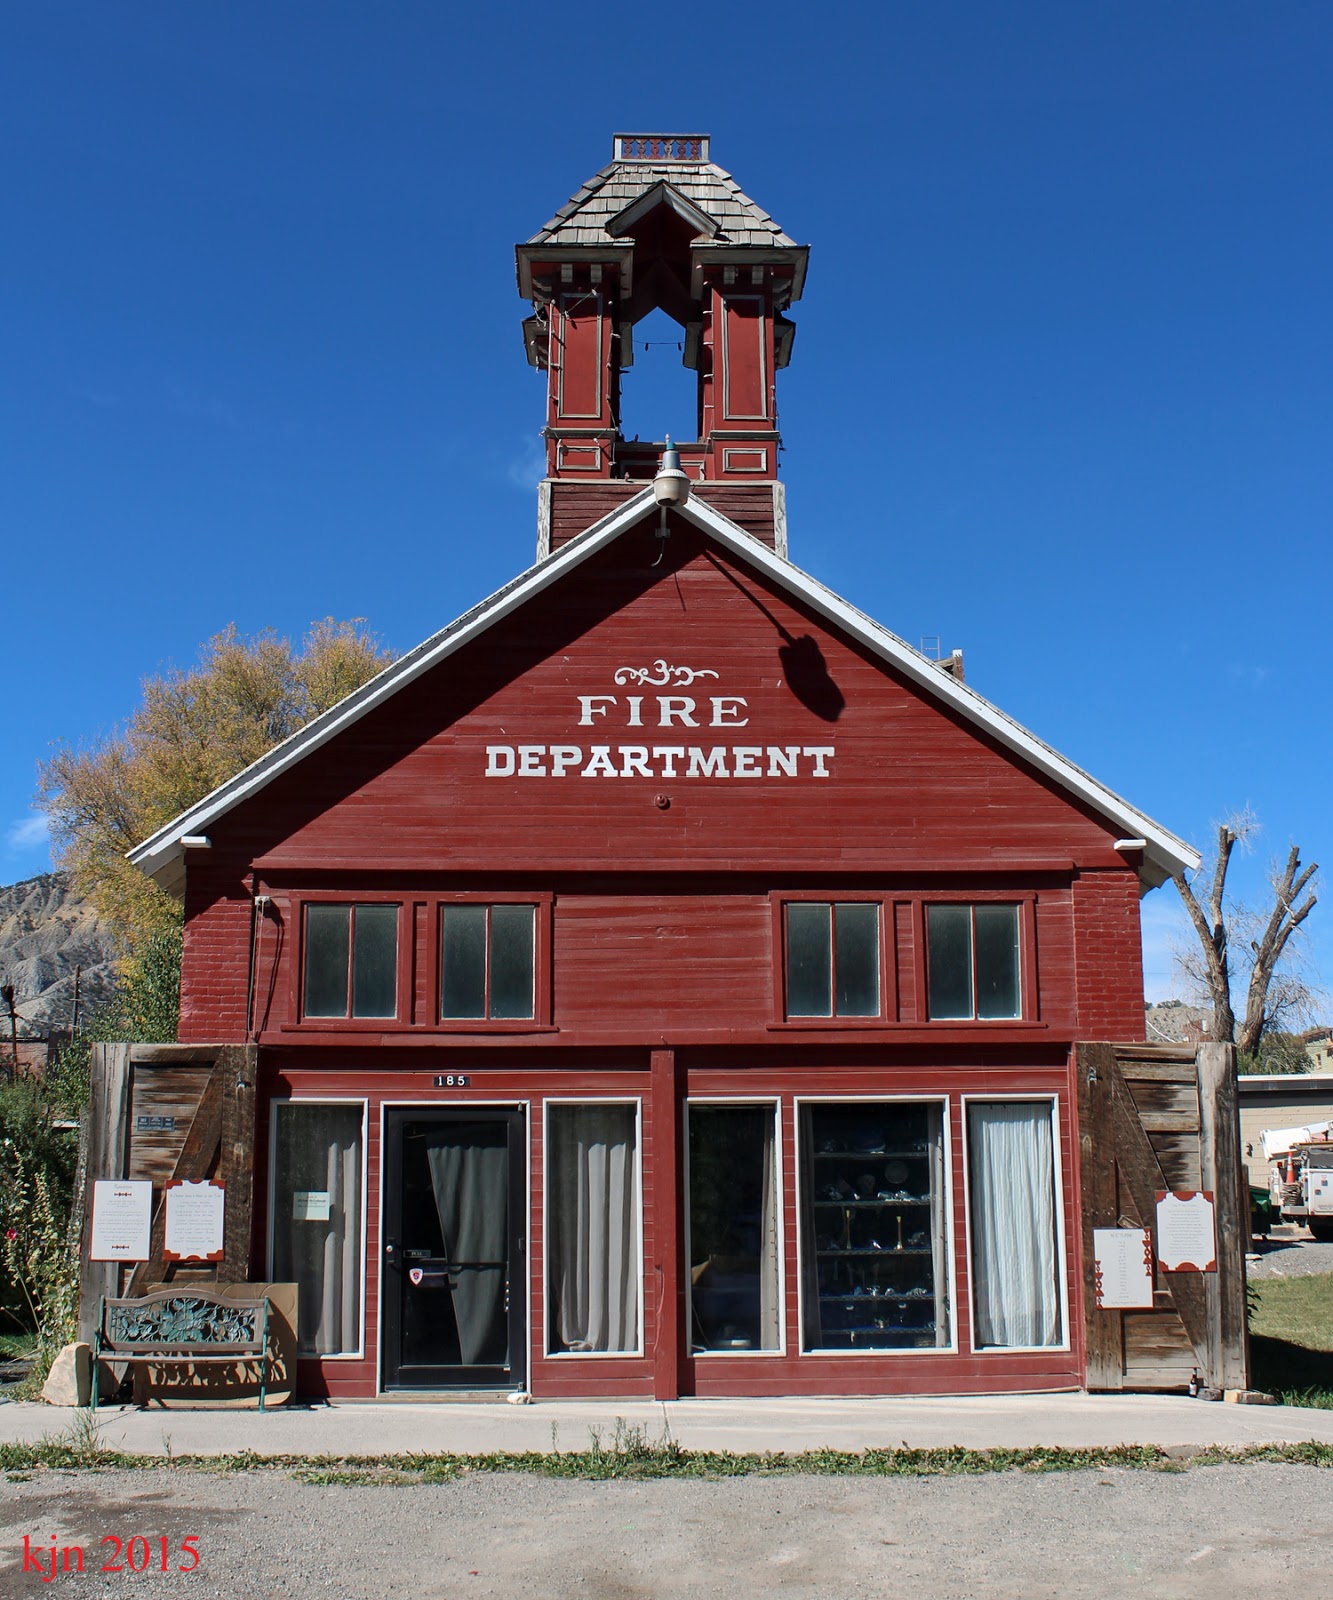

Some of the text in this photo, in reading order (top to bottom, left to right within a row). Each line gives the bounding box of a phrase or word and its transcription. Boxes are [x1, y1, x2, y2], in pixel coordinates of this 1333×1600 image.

[576, 695, 749, 727] FIRE
[485, 745, 835, 778] DEPARTMENT
[438, 1075, 465, 1086] 185
